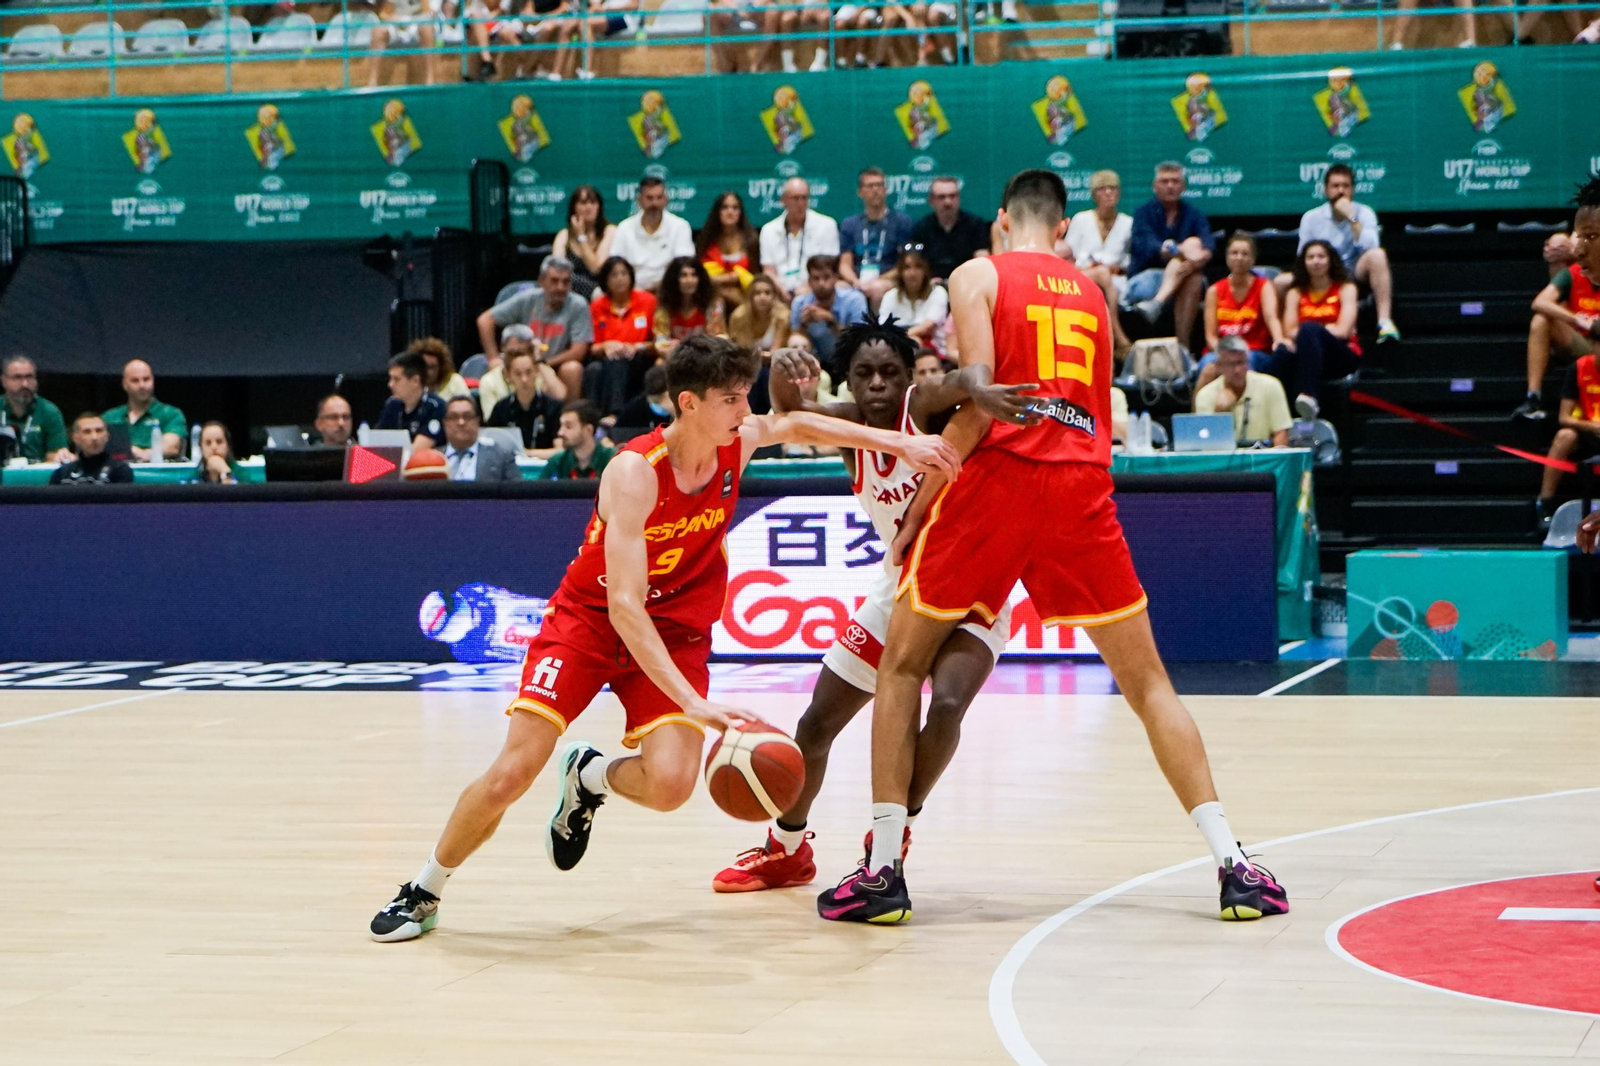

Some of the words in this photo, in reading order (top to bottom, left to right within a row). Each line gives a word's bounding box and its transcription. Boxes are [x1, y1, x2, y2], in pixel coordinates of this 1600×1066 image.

[1187, 173, 1221, 185] WORLD
[1223, 171, 1242, 184] CUP
[1444, 158, 1473, 179] U17
[1475, 165, 1509, 177] WORLD
[1511, 164, 1531, 177] CUP
[748, 179, 777, 198] U17
[112, 197, 137, 216] U17
[234, 194, 262, 212] U17
[360, 190, 387, 209] U17
[1026, 304, 1098, 387] 15
[643, 507, 725, 542] ESPAÑA
[648, 547, 684, 576] 9
[139, 673, 413, 688] CUP
[531, 656, 563, 690] fi
